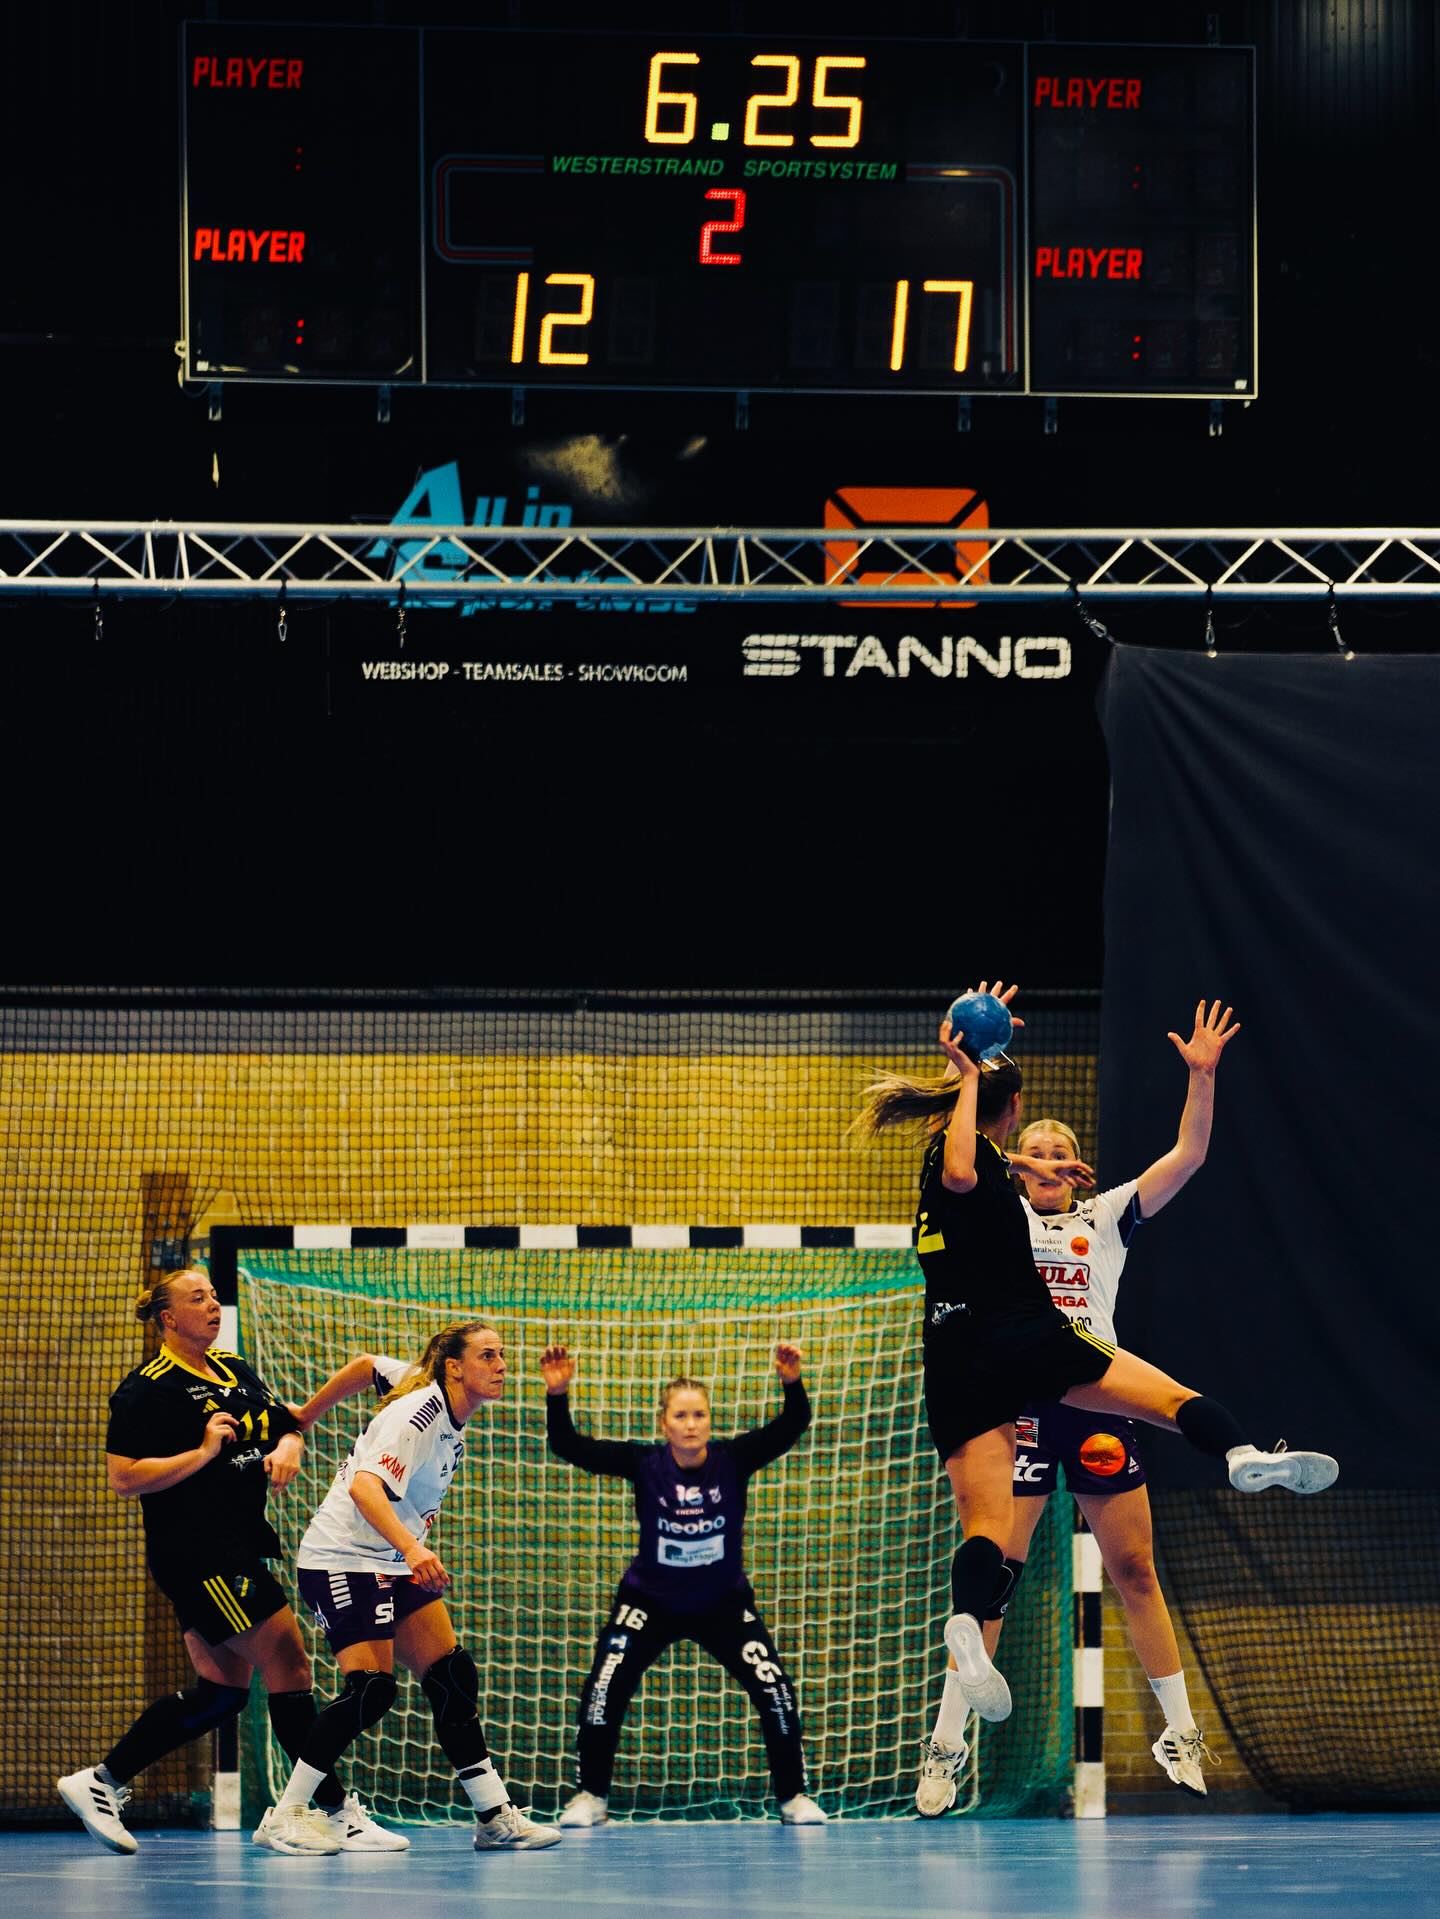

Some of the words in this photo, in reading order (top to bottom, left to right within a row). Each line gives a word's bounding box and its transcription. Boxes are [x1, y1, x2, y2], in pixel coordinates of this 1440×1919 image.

[193, 56, 303, 89] PLAYER
[643, 51, 867, 149] 6.25
[1034, 76, 1142, 109] PLAYER
[552, 156, 725, 176] WESTERSTRAND
[743, 159, 898, 180] SPORTSYSTEM
[699, 188, 747, 265] 2
[193, 228, 306, 264] PLAYER
[1035, 246, 1143, 280] PLAYER
[510, 272, 595, 366] 12
[889, 279, 974, 373] 17
[361, 661, 450, 681] WEBSHOP
[462, 662, 565, 682] TEAMSALES
[578, 664, 688, 683] SHOWROOM
[741, 634, 1072, 679] STANNO
[1037, 1265, 1087, 1286] ULA
[675, 1483, 704, 1507] 16
[657, 1515, 726, 1535] neobo
[615, 1603, 649, 1631] 16
